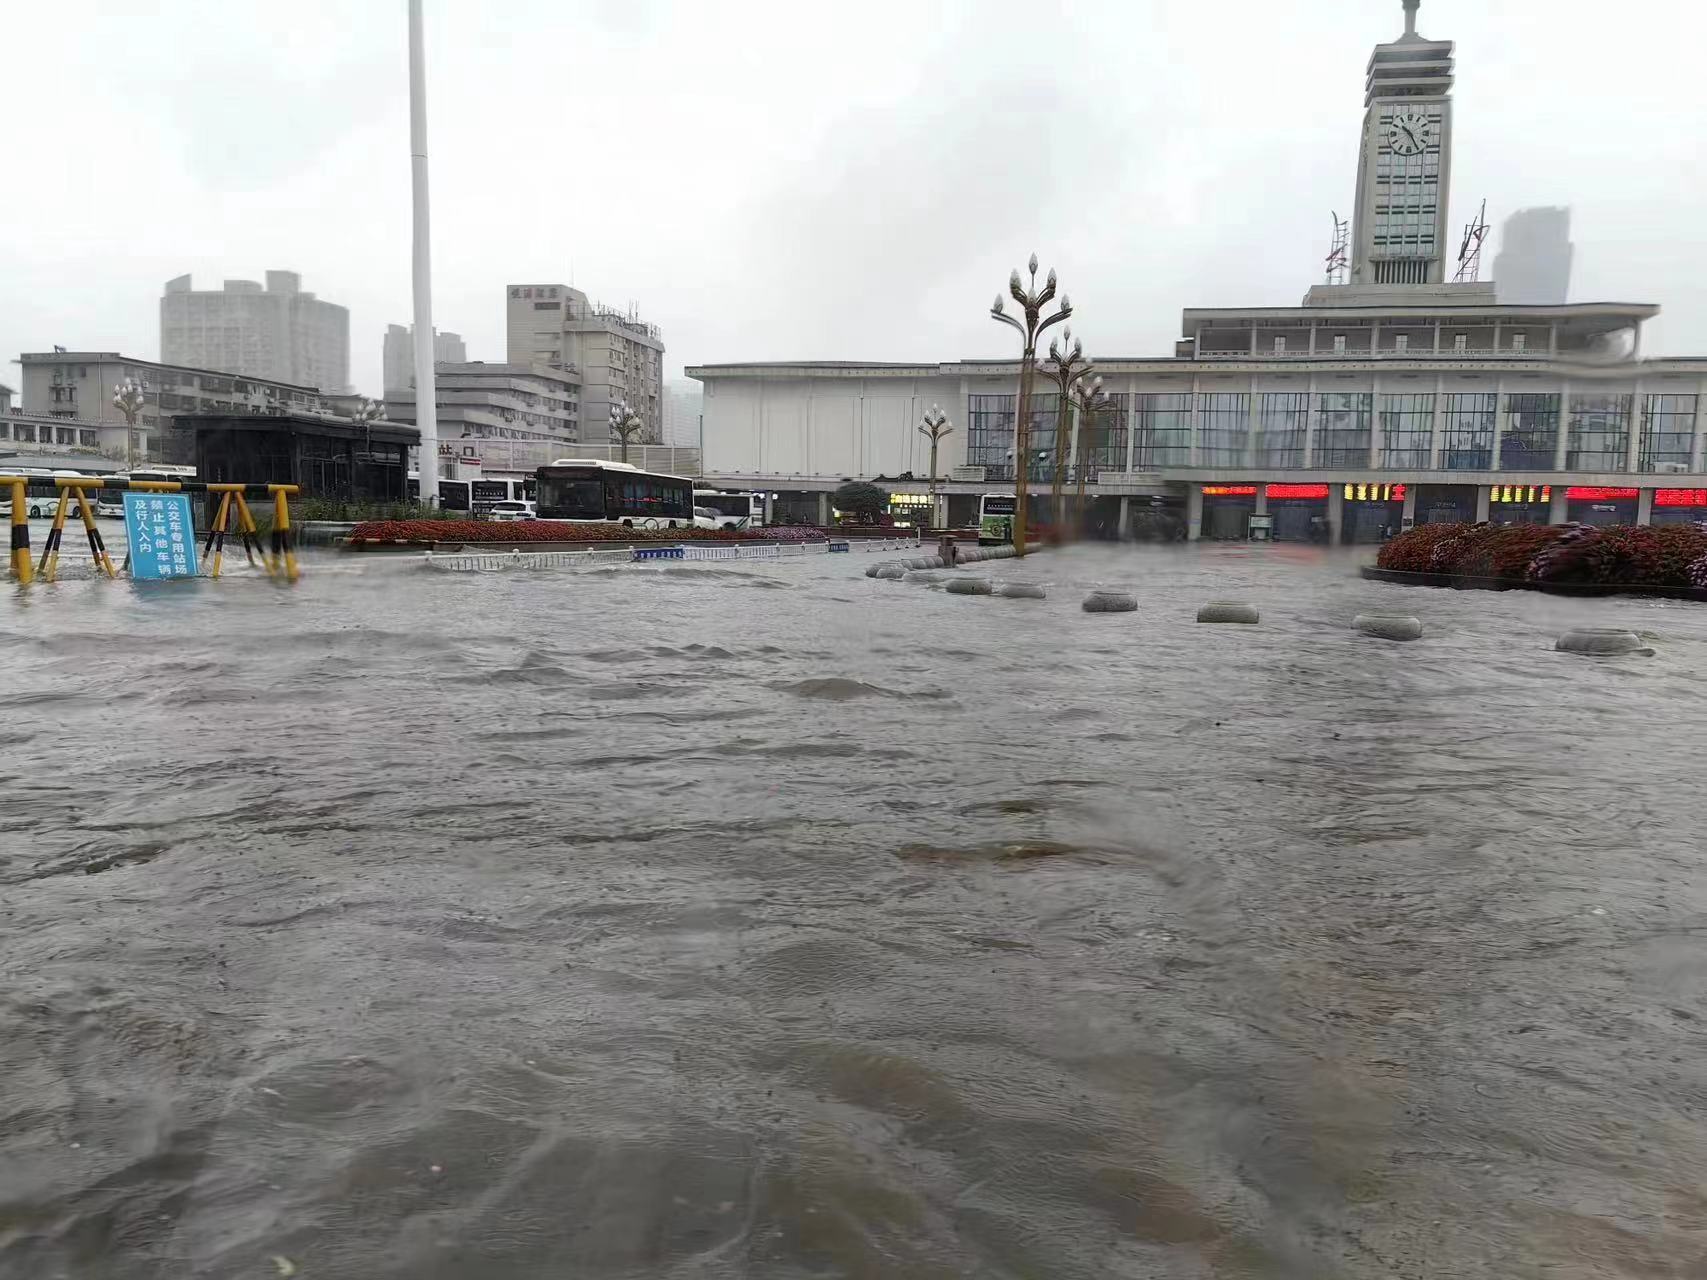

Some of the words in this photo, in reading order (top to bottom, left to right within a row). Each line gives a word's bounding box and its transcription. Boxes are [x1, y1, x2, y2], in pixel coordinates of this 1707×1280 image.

[135, 500, 151, 553] 及行人入内
[151, 501, 171, 575] 禁止其他车辆
